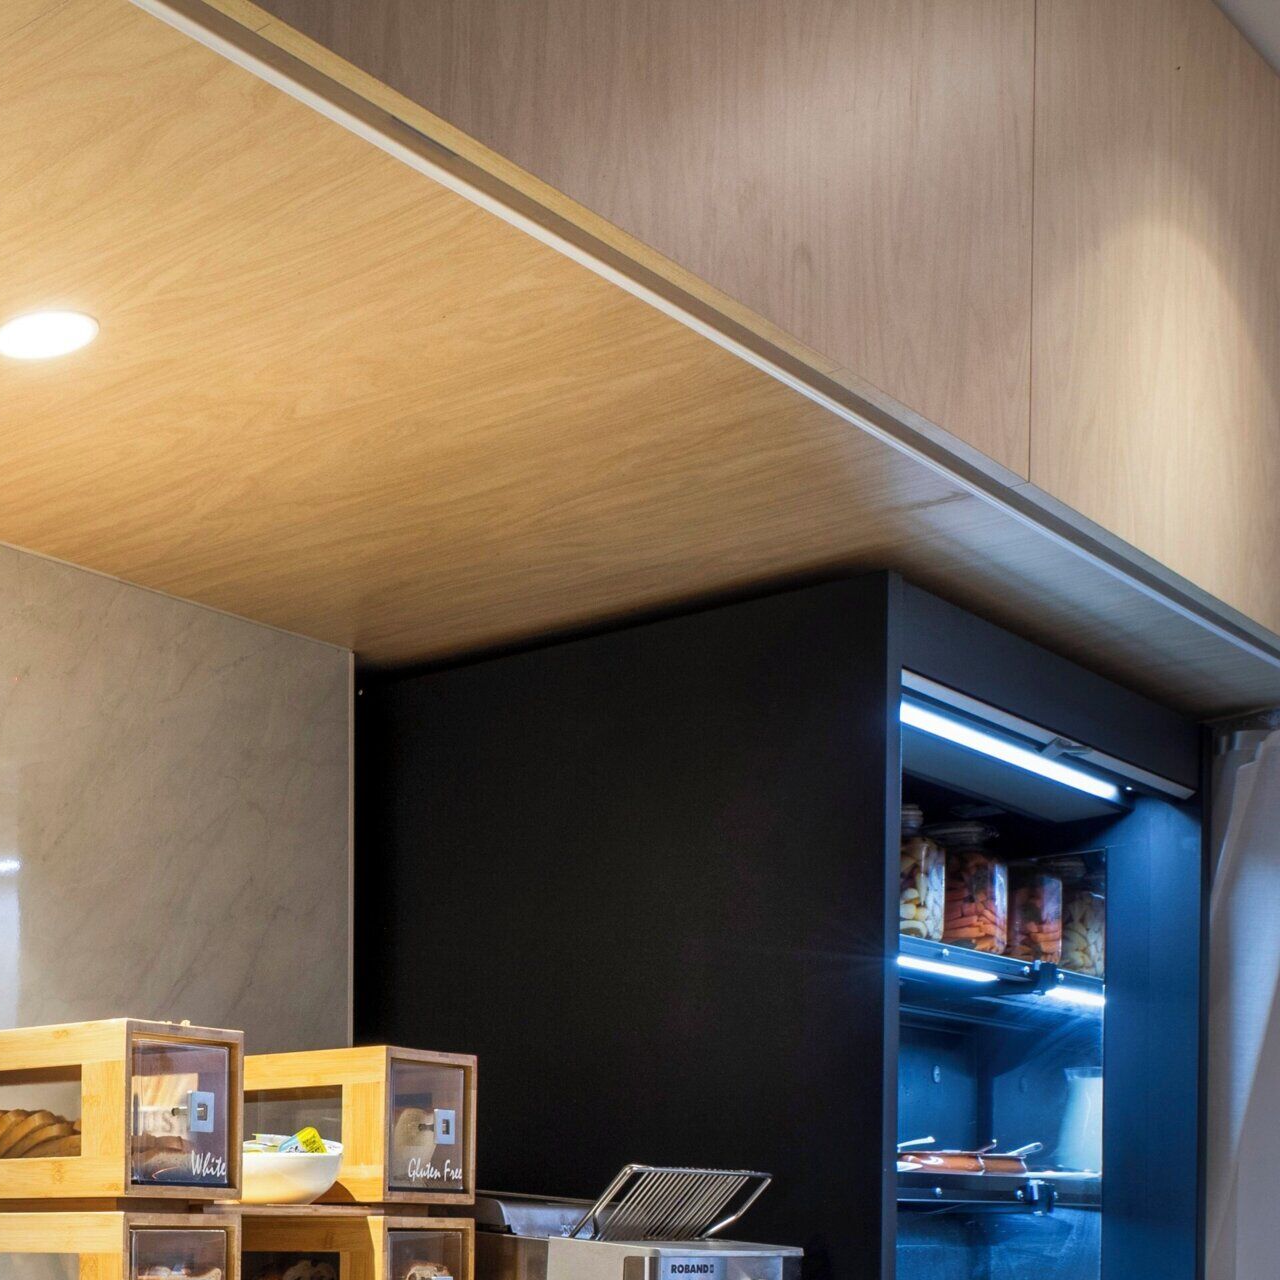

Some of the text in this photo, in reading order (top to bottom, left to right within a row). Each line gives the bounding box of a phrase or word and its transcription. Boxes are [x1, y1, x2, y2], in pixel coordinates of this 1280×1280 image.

[191, 1150, 227, 1177] White
[408, 1158, 463, 1182] Gluten Free
[670, 1264, 709, 1274] ROBAND
